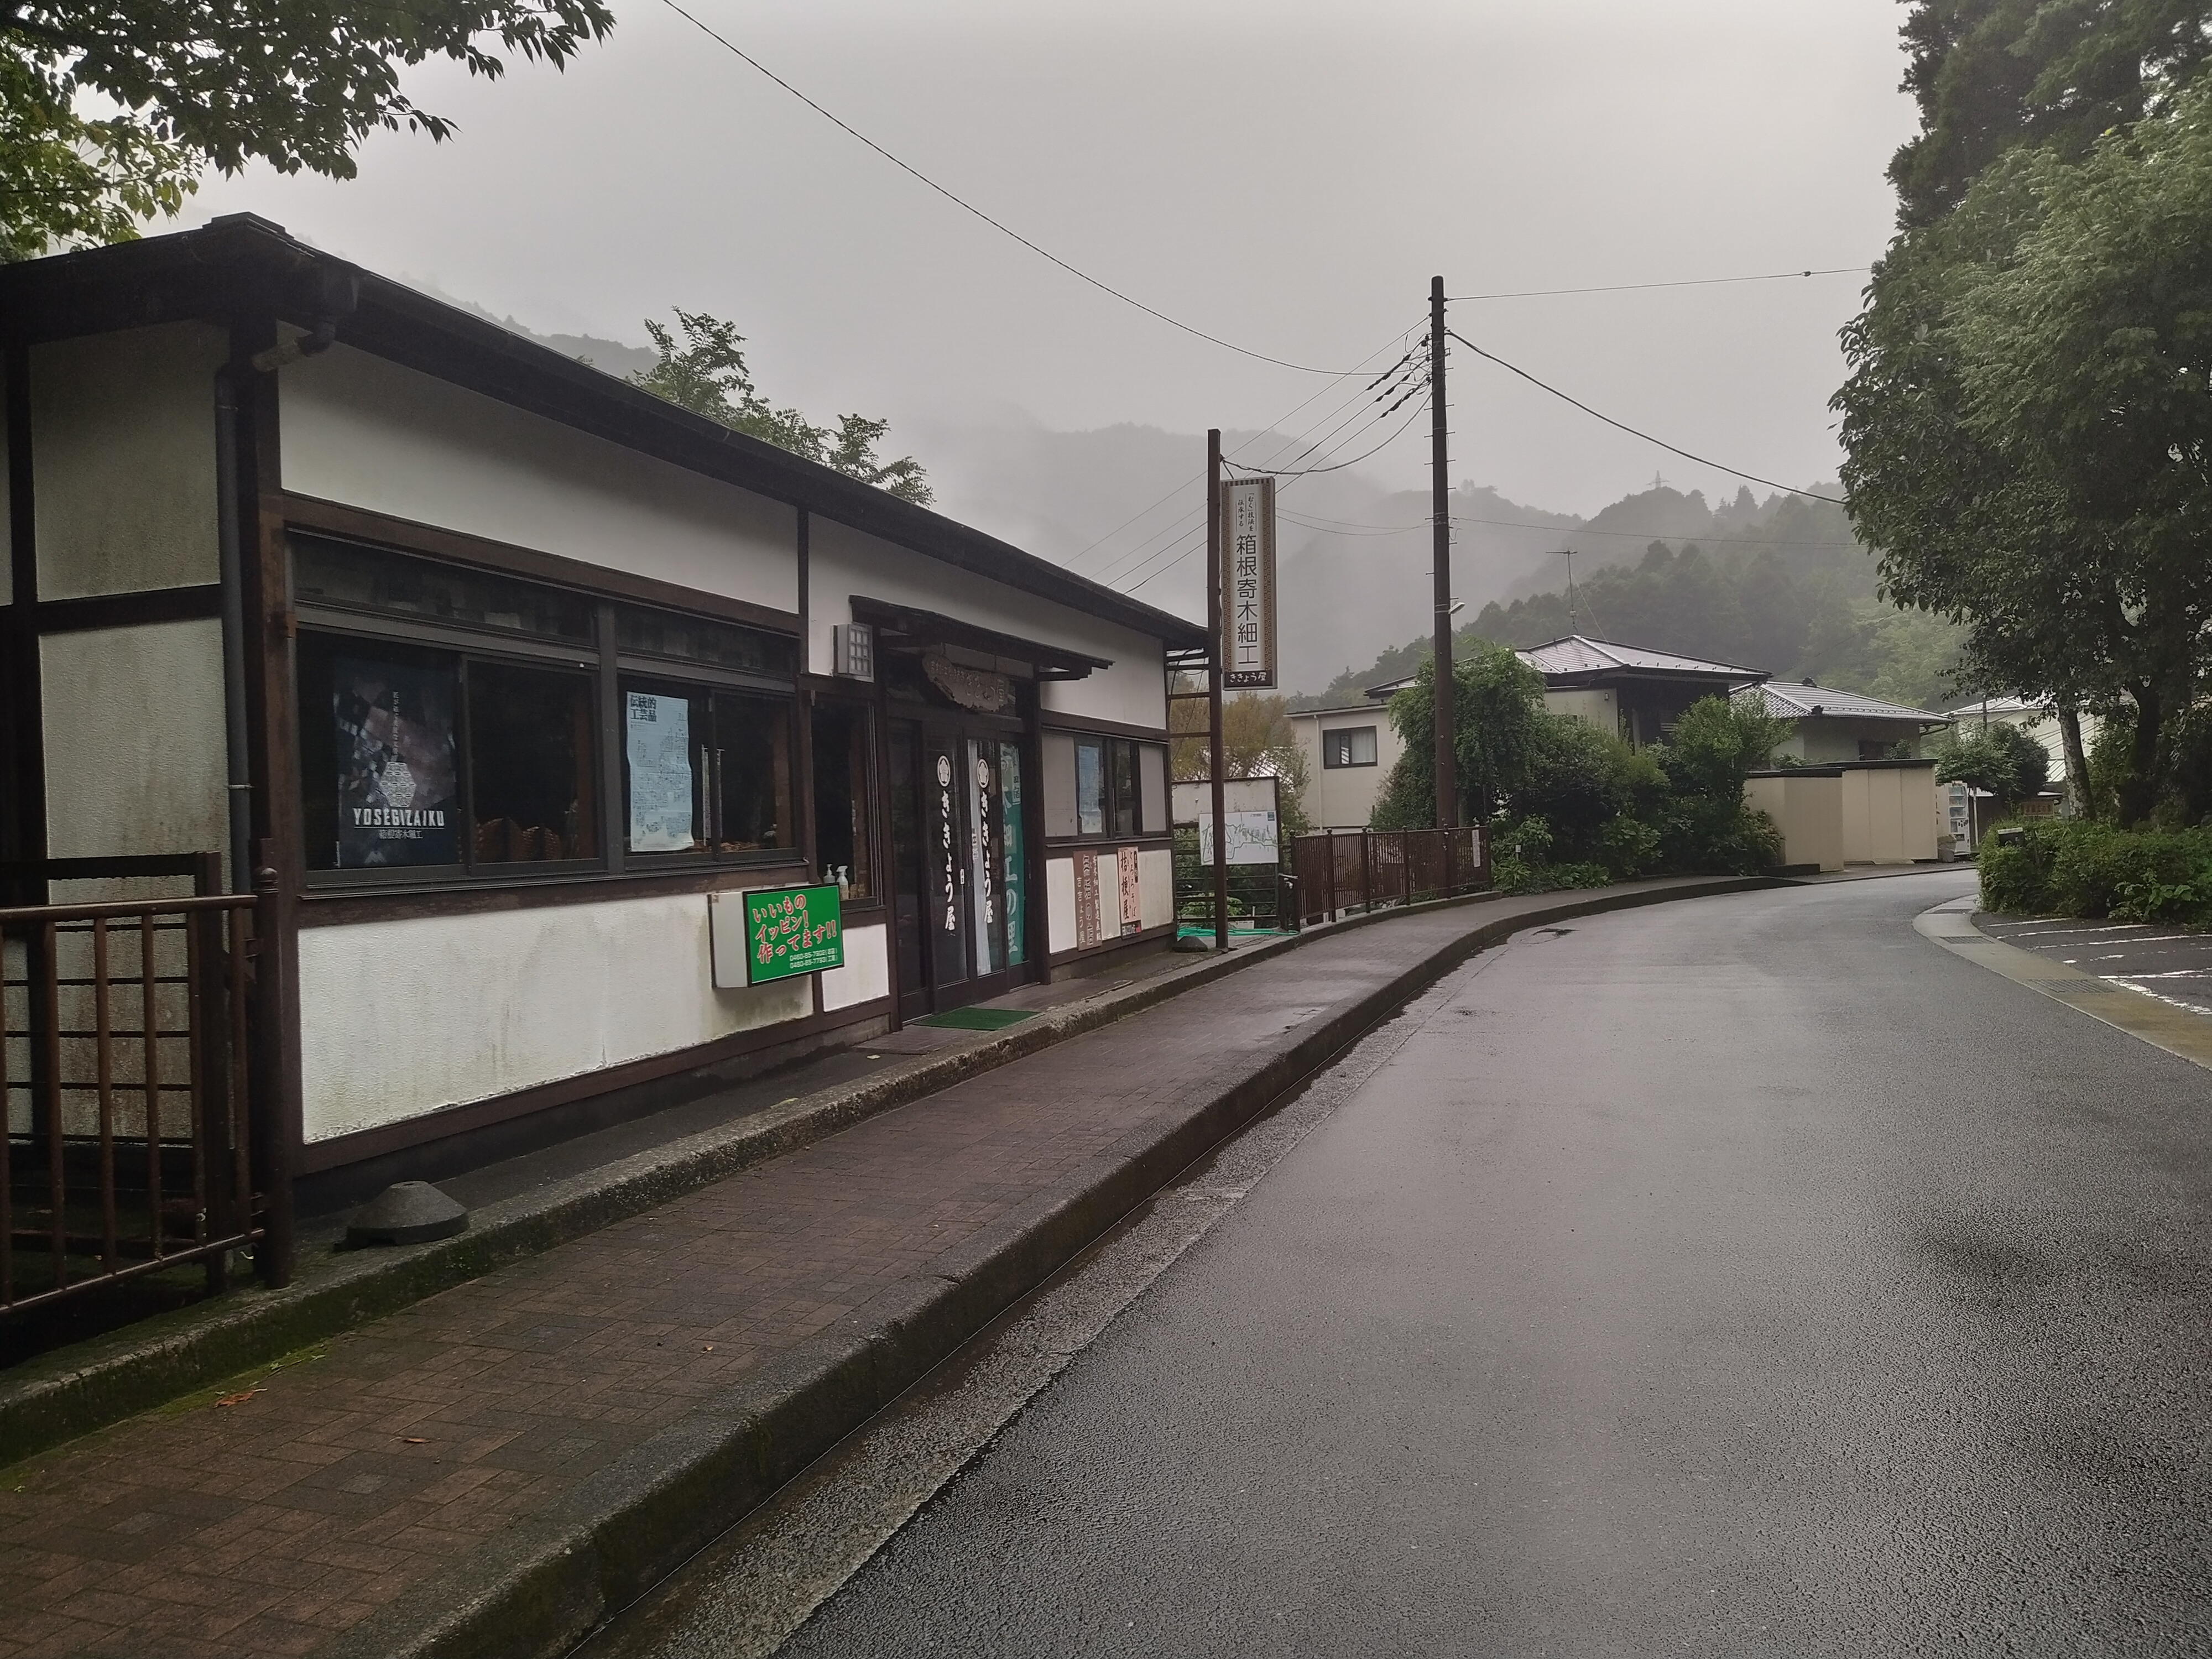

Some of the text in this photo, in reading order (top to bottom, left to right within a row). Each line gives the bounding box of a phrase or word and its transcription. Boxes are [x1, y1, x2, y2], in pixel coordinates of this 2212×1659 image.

[1236, 534, 1259, 665] 箱根寄木細工
[1229, 671, 1267, 683] ききょう屋
[630, 695, 657, 709] 伝統的
[630, 708, 657, 722] 工芸品
[353, 807, 445, 827] YOSEGIZAIKU
[942, 790, 955, 931] ききょう屋
[981, 791, 993, 924] ききょう屋
[752, 894, 807, 923] いいもの
[755, 910, 809, 942] イッピン!
[757, 920, 837, 964] 作ってます!!
